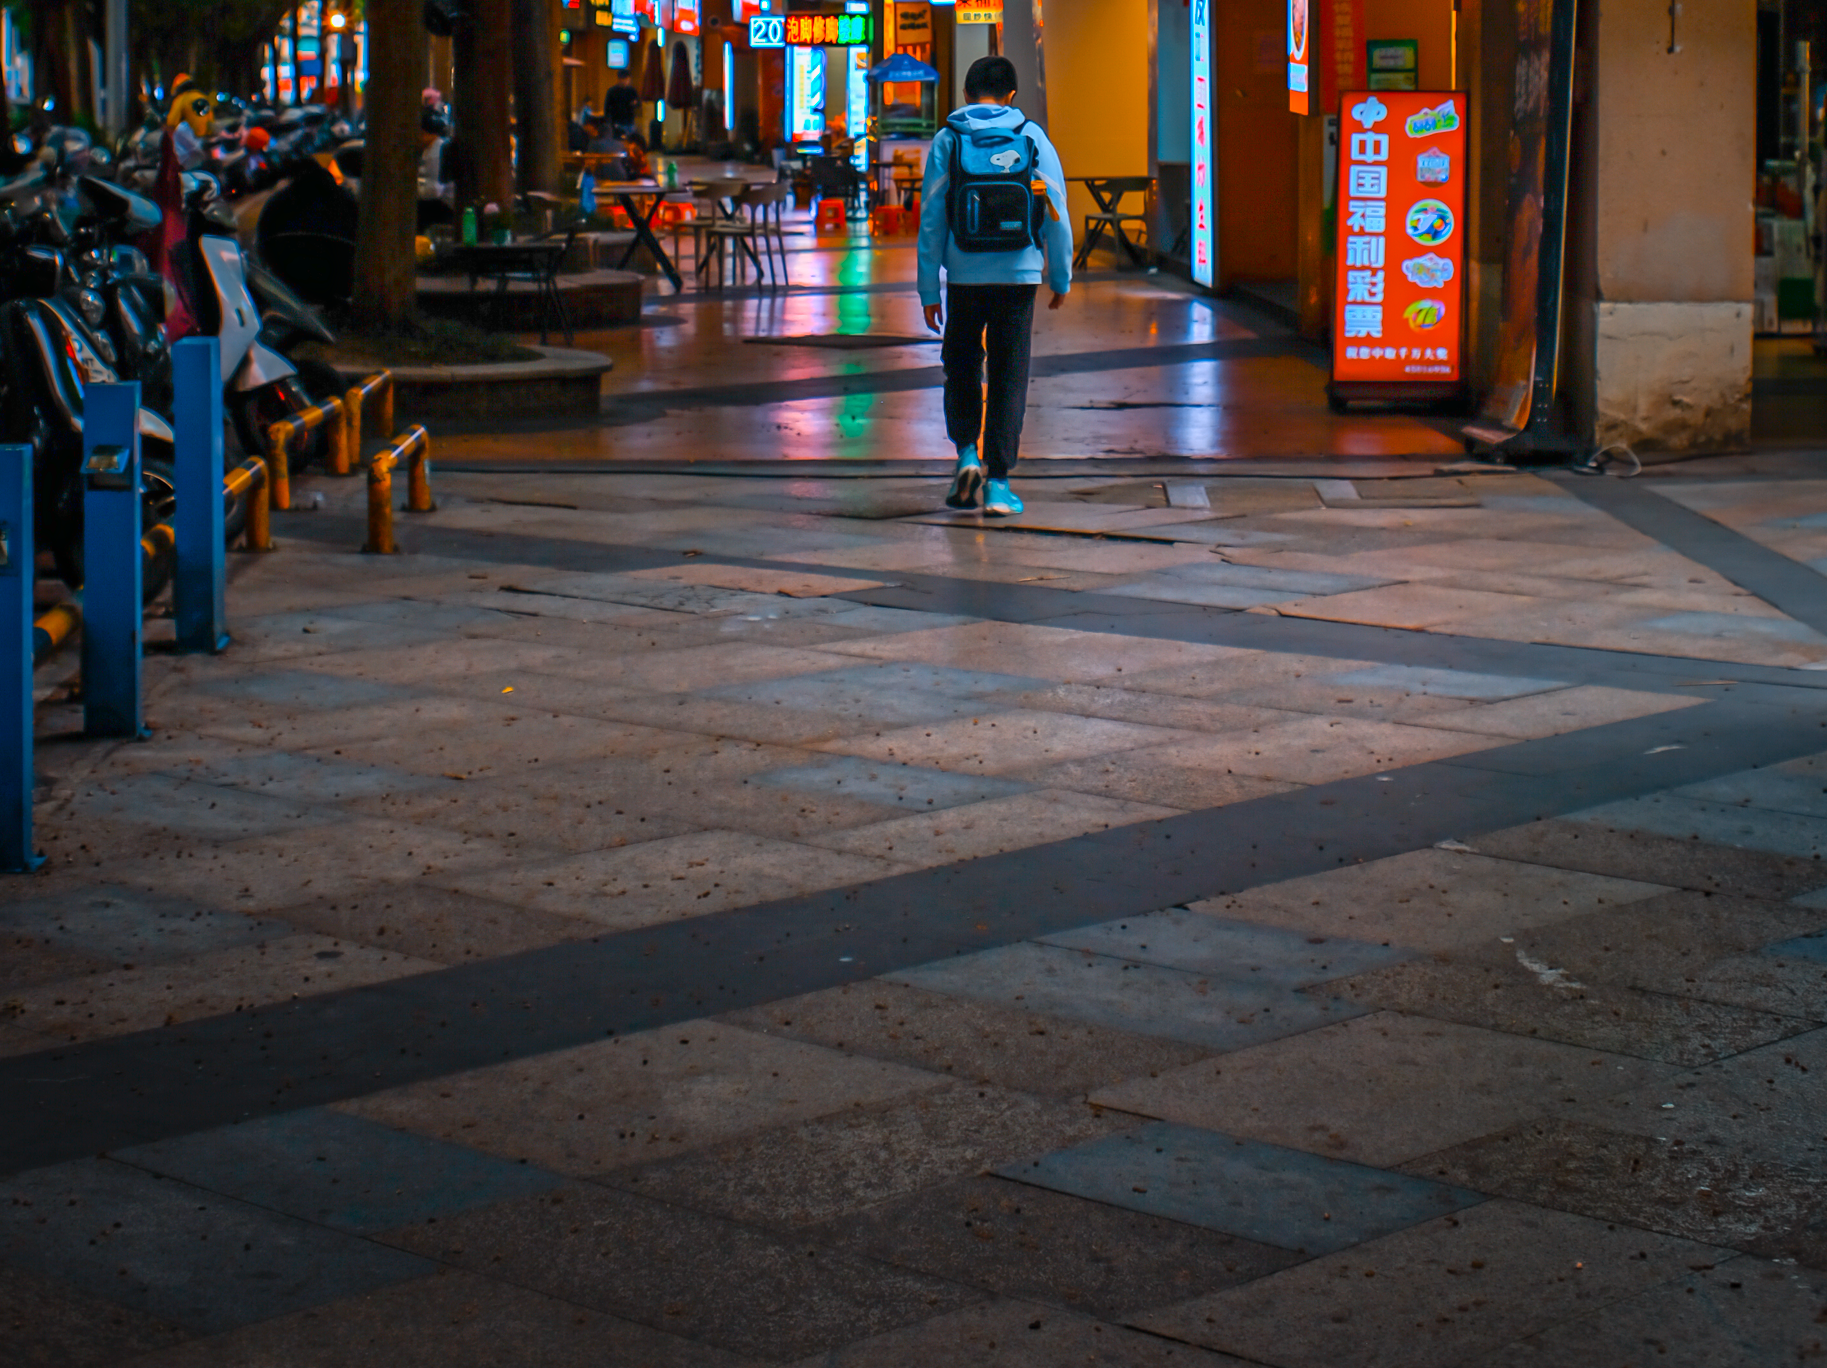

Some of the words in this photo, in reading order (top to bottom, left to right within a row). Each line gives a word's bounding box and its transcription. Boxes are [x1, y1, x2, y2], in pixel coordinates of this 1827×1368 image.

[753, 21, 781, 43] 20
[1344, 130, 1390, 338] 中国福利彩票
